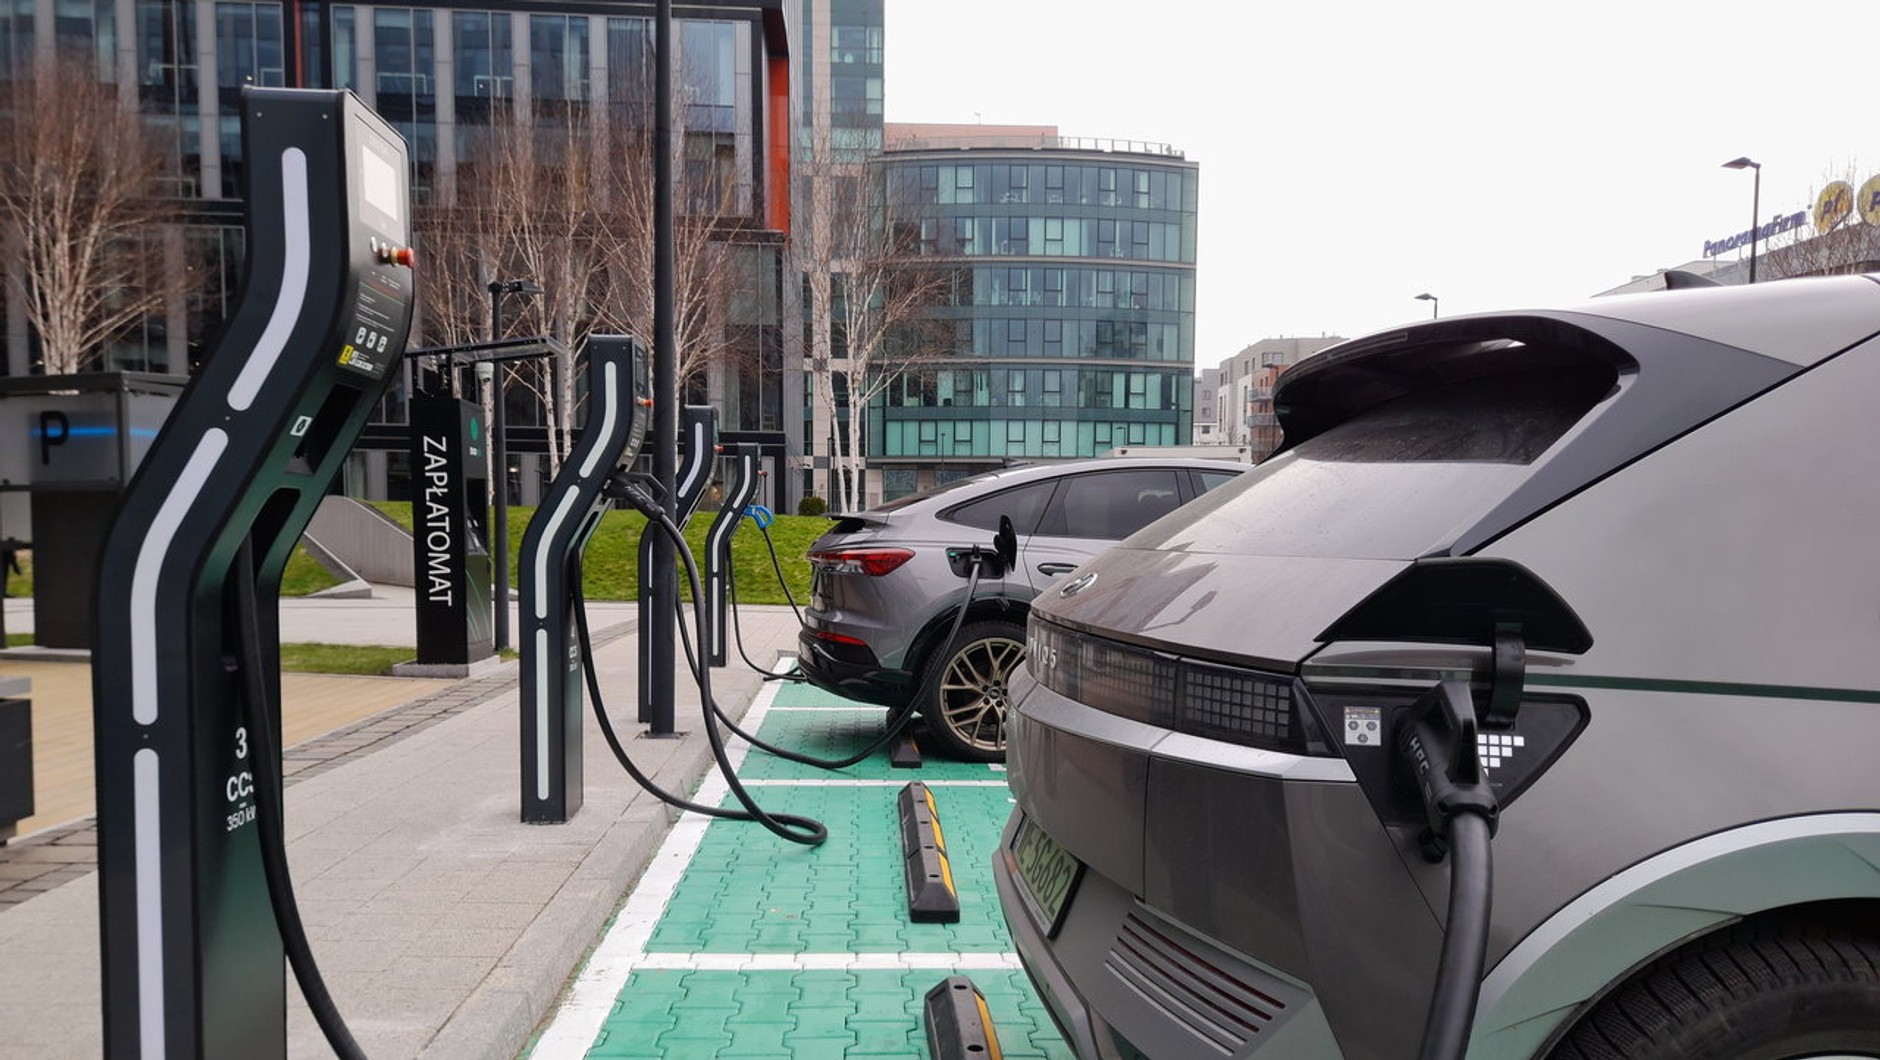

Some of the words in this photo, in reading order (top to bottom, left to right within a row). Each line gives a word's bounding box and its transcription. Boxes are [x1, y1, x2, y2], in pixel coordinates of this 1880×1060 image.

[40, 410, 69, 465] P
[423, 435, 452, 607] ZAPŁATOMAT
[235, 726, 248, 759] 3
[226, 810, 245, 832] 350
